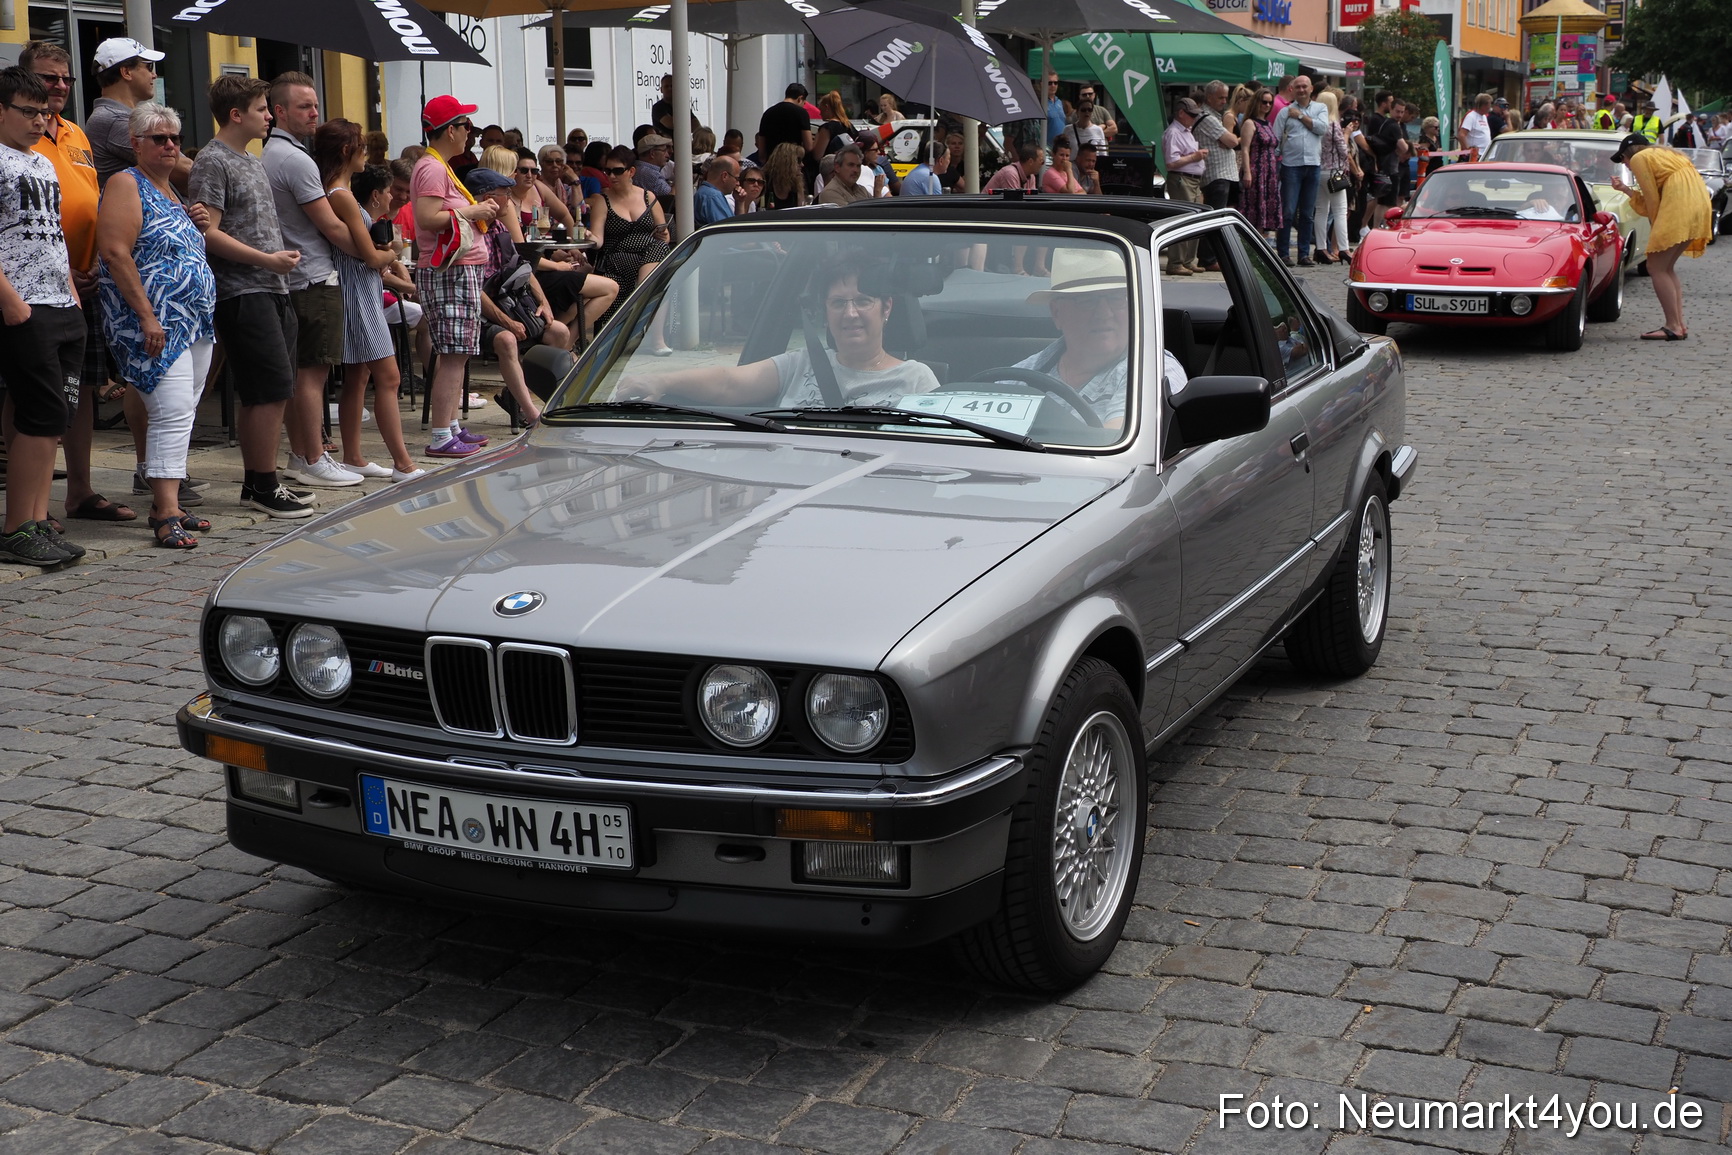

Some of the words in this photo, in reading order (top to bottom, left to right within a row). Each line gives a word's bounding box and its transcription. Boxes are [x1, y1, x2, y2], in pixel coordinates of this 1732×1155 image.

[1344, 3, 1369, 13] WITT
[650, 44, 664, 65] 30
[636, 70, 661, 92] Bang
[1414, 296, 1440, 311] SUL
[962, 400, 1013, 414] 410
[373, 812, 382, 825] D
[387, 786, 459, 841] NEA
[486, 803, 539, 852] WN
[550, 810, 601, 857] 4H
[602, 814, 622, 828] 05
[403, 841, 424, 852] BMW
[427, 845, 457, 857] GROUP
[461, 850, 534, 868] NIEDERLASSUNG
[538, 861, 588, 874] HANNOVER
[607, 846, 625, 859] 10
